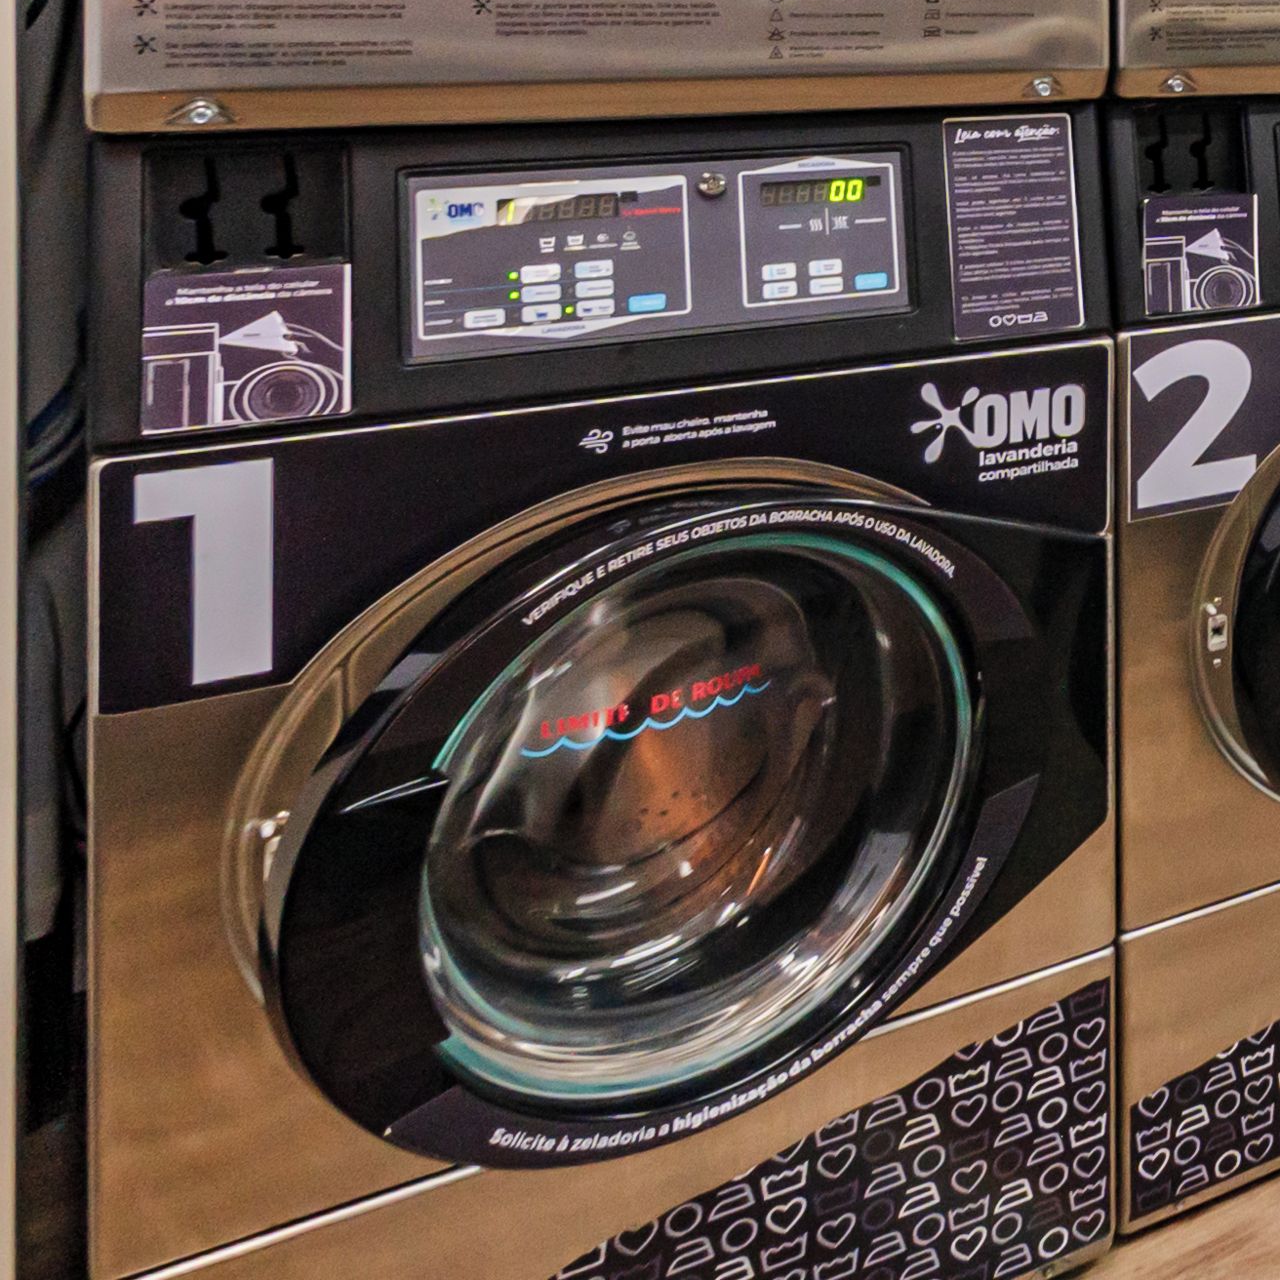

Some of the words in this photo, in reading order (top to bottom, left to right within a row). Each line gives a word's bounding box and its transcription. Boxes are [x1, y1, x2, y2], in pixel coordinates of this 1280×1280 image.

[622, 425, 649, 436] Evite
[974, 384, 1085, 448] OMO
[1133, 339, 1257, 510] 2
[632, 436, 660, 449] porta
[663, 430, 696, 443] aberta
[979, 439, 1077, 467] lavanderia
[978, 457, 1079, 482] compartilhada
[133, 457, 274, 685] 1
[522, 572, 594, 626] VERIFIQUE
[596, 566, 607, 579] E
[608, 541, 654, 575] RETIRE
[656, 529, 689, 551] SEUS
[690, 516, 747, 540] OBJETOS
[749, 512, 767, 526] DA
[768, 509, 833, 523] BORRACHA
[834, 512, 864, 529] APÓS
[866, 516, 875, 529] O
[875, 518, 896, 537] USO
[897, 527, 912, 545] DA
[650, 689, 683, 715] DE
[489, 1126, 554, 1152] Solicite
[571, 1125, 657, 1151] zeladoria
[659, 1122, 670, 1136] a
[673, 1072, 788, 1135] higienização
[788, 1058, 811, 1077] da
[810, 1000, 883, 1061] borracha
[881, 944, 932, 1003] sempre
[928, 918, 952, 948] que
